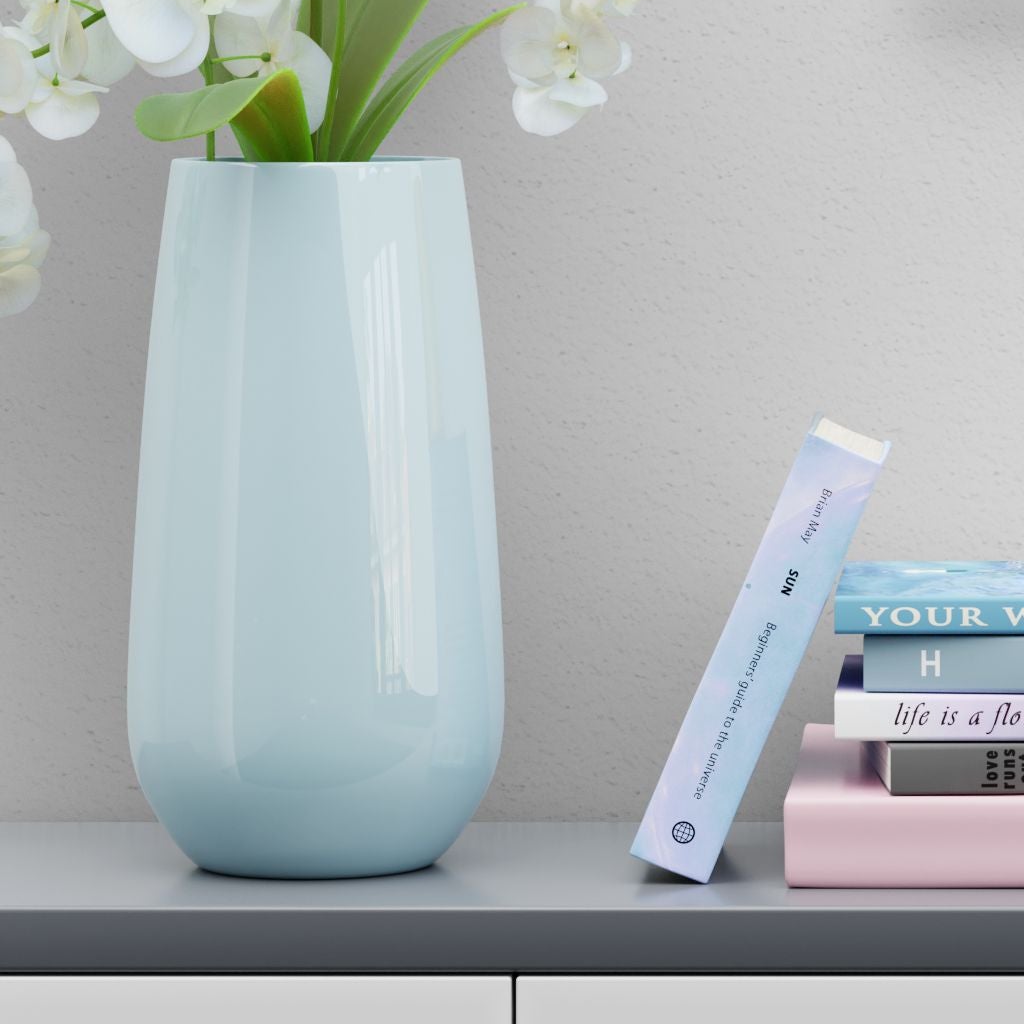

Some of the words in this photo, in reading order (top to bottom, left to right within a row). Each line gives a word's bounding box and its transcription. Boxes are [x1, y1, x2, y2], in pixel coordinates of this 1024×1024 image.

[813, 488, 832, 517] Brian
[800, 520, 819, 544] May
[780, 568, 799, 596] SUN
[861, 606, 988, 627] YOUR
[729, 681, 749, 714] guide
[723, 716, 735, 728] to
[894, 702, 930, 735] life
[941, 705, 958, 726] is
[968, 711, 984, 726] a
[714, 730, 729, 750] the
[693, 752, 719, 800] universe
[980, 750, 999, 788] love
[1003, 748, 1016, 790] runs
